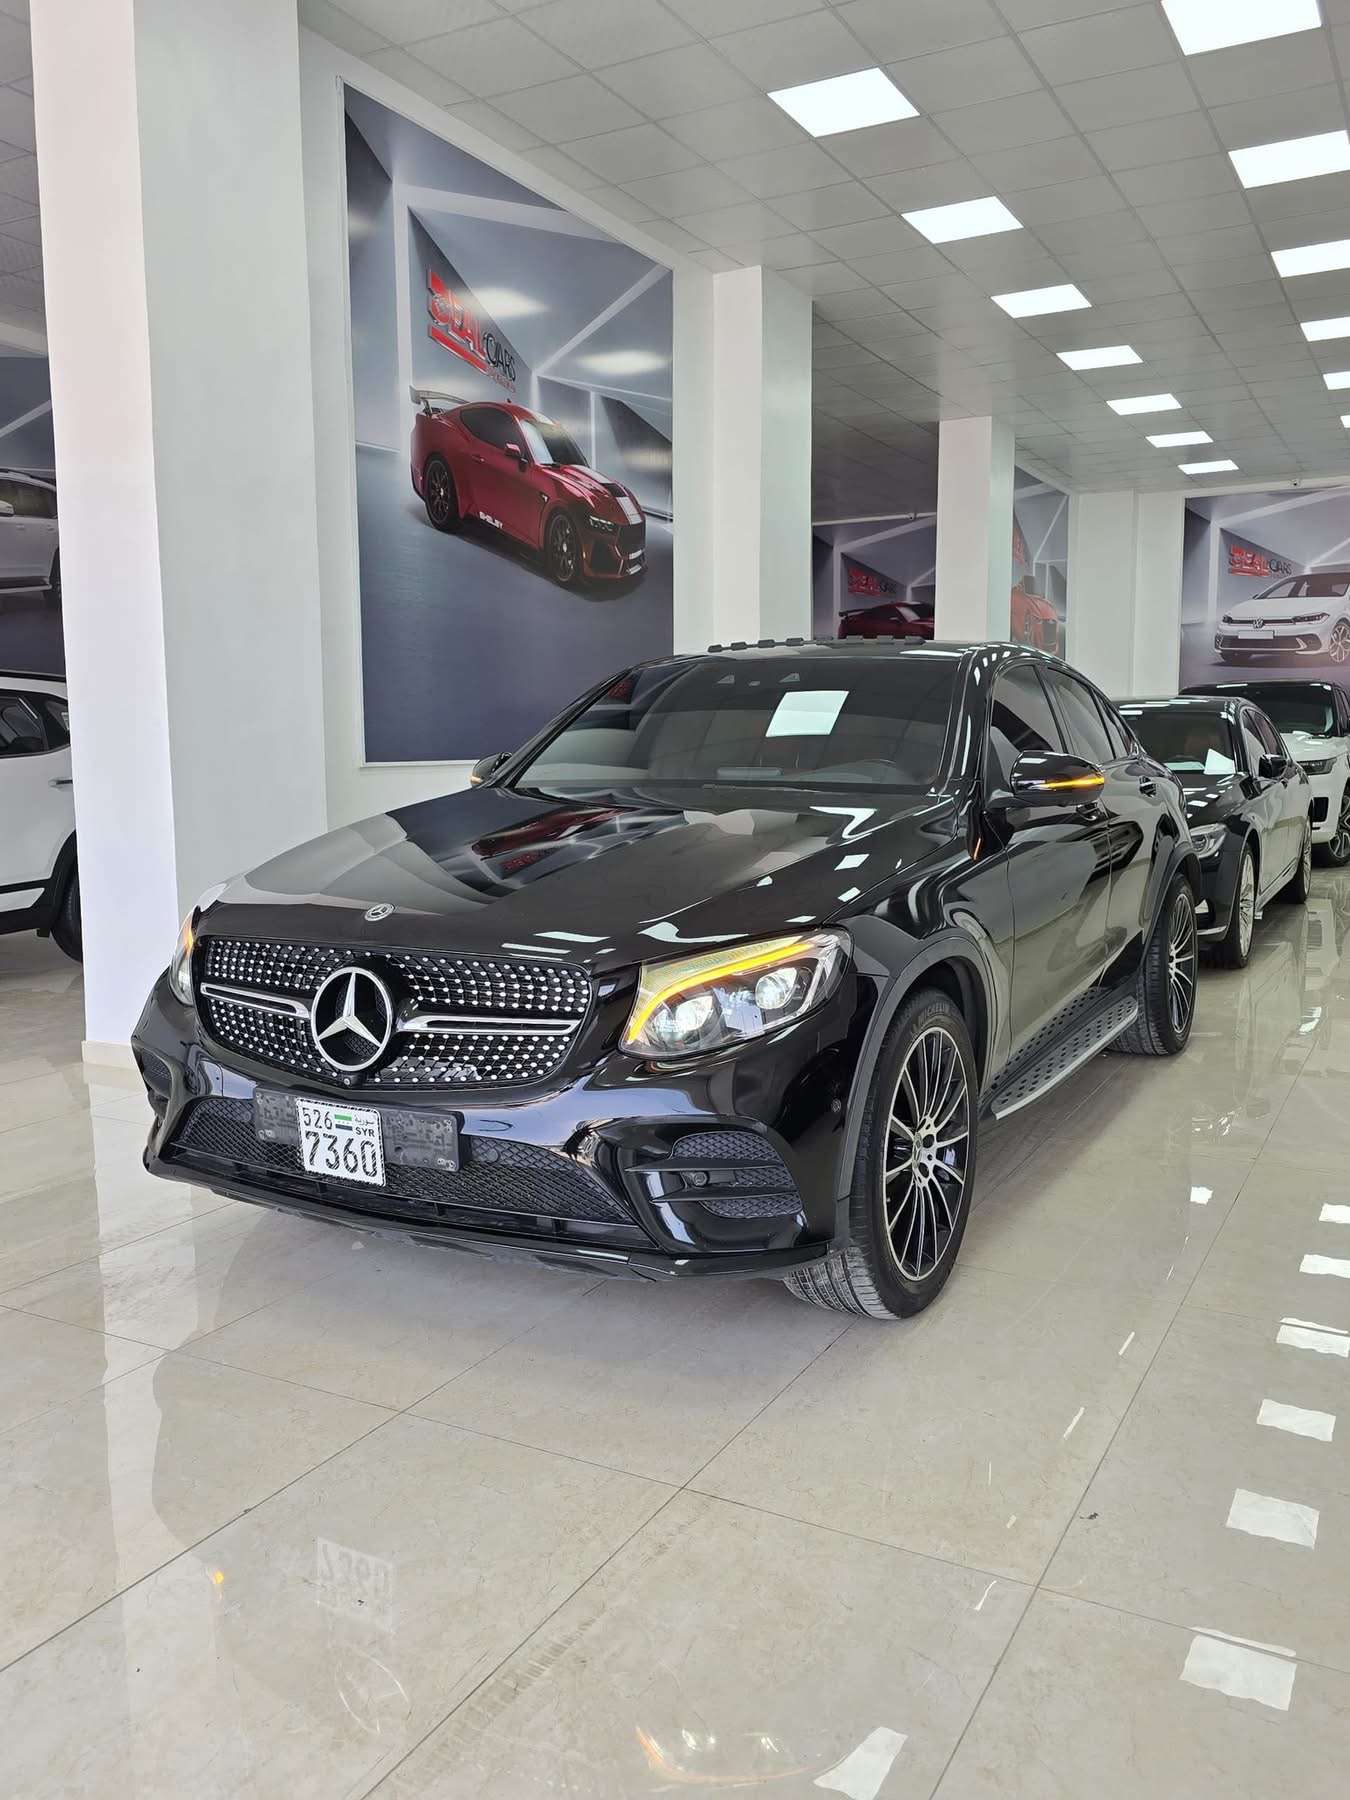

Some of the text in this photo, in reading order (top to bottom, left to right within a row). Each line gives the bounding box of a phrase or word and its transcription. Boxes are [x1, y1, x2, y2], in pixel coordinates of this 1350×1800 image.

[302, 1107, 333, 1130] 526
[355, 1114, 375, 1125] سورية
[355, 1126, 375, 1138] SYR
[305, 1130, 378, 1177] 7360
